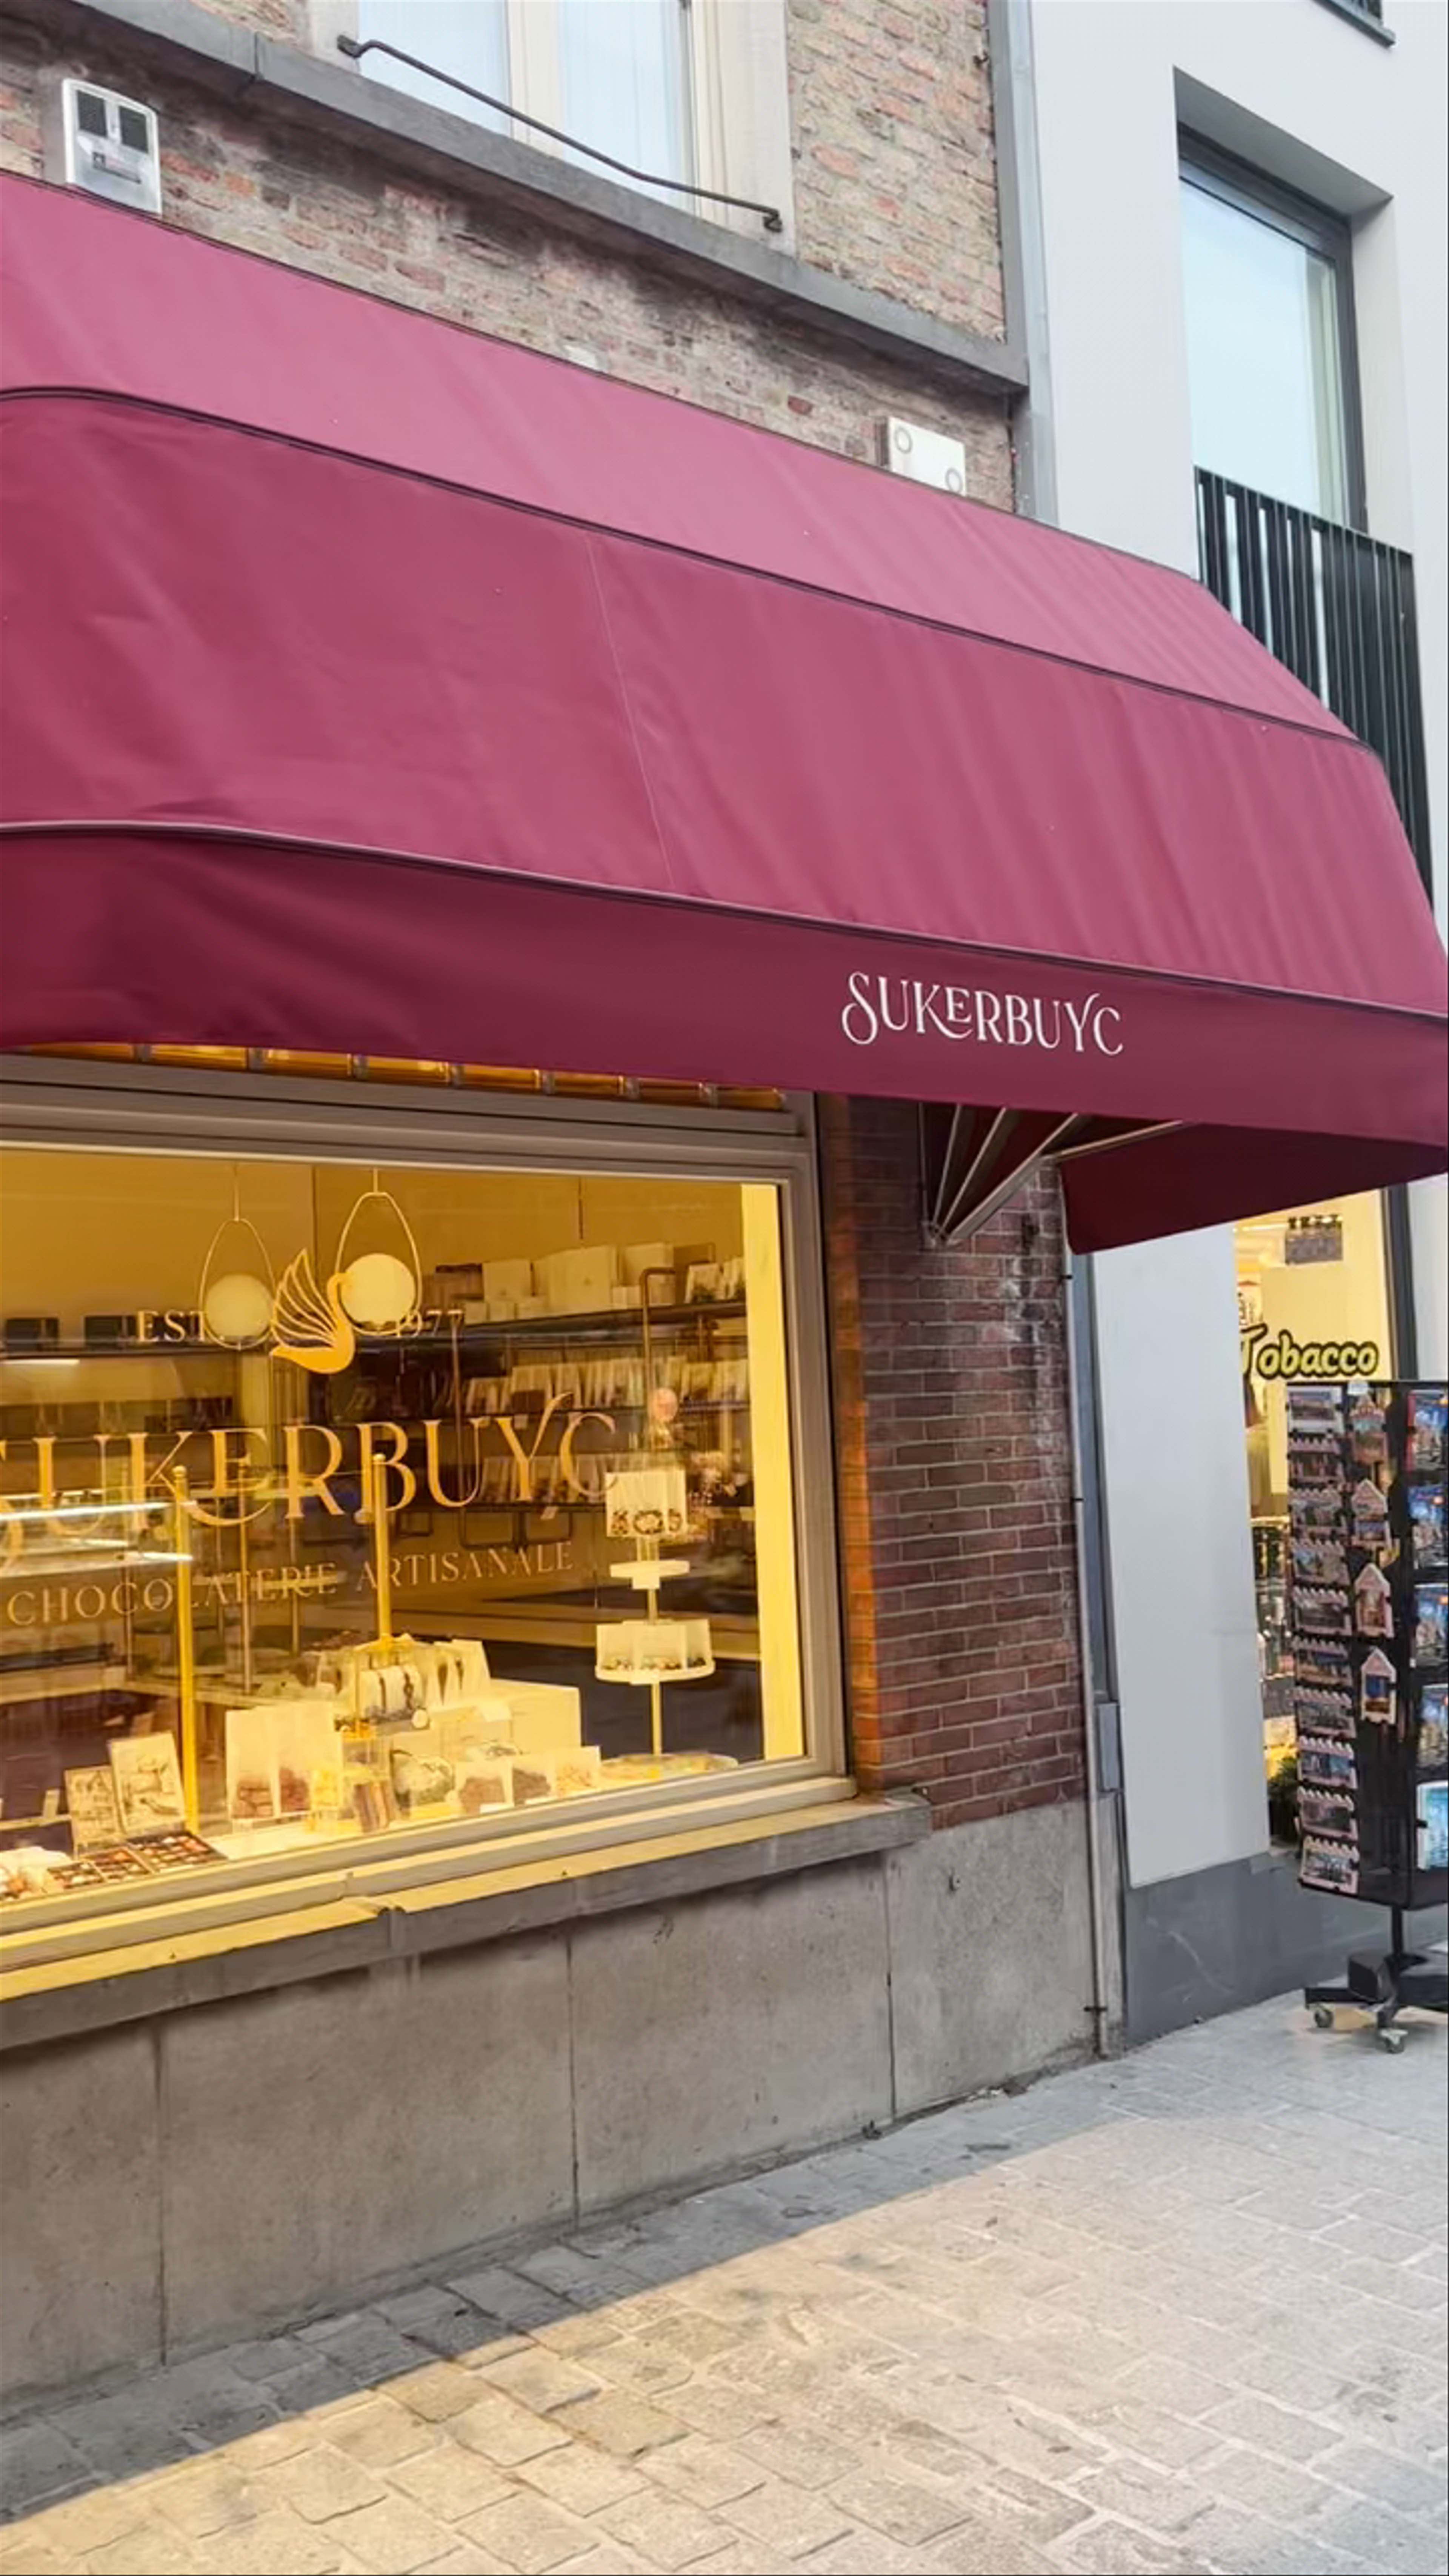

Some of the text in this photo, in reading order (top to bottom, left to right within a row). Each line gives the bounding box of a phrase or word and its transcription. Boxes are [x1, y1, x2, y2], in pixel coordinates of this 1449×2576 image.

[841, 971, 1123, 1056] SUKERBUYC
[0, 1391, 617, 1573] UKERBUYC
[355, 1540, 574, 1592] ARTISANALE
